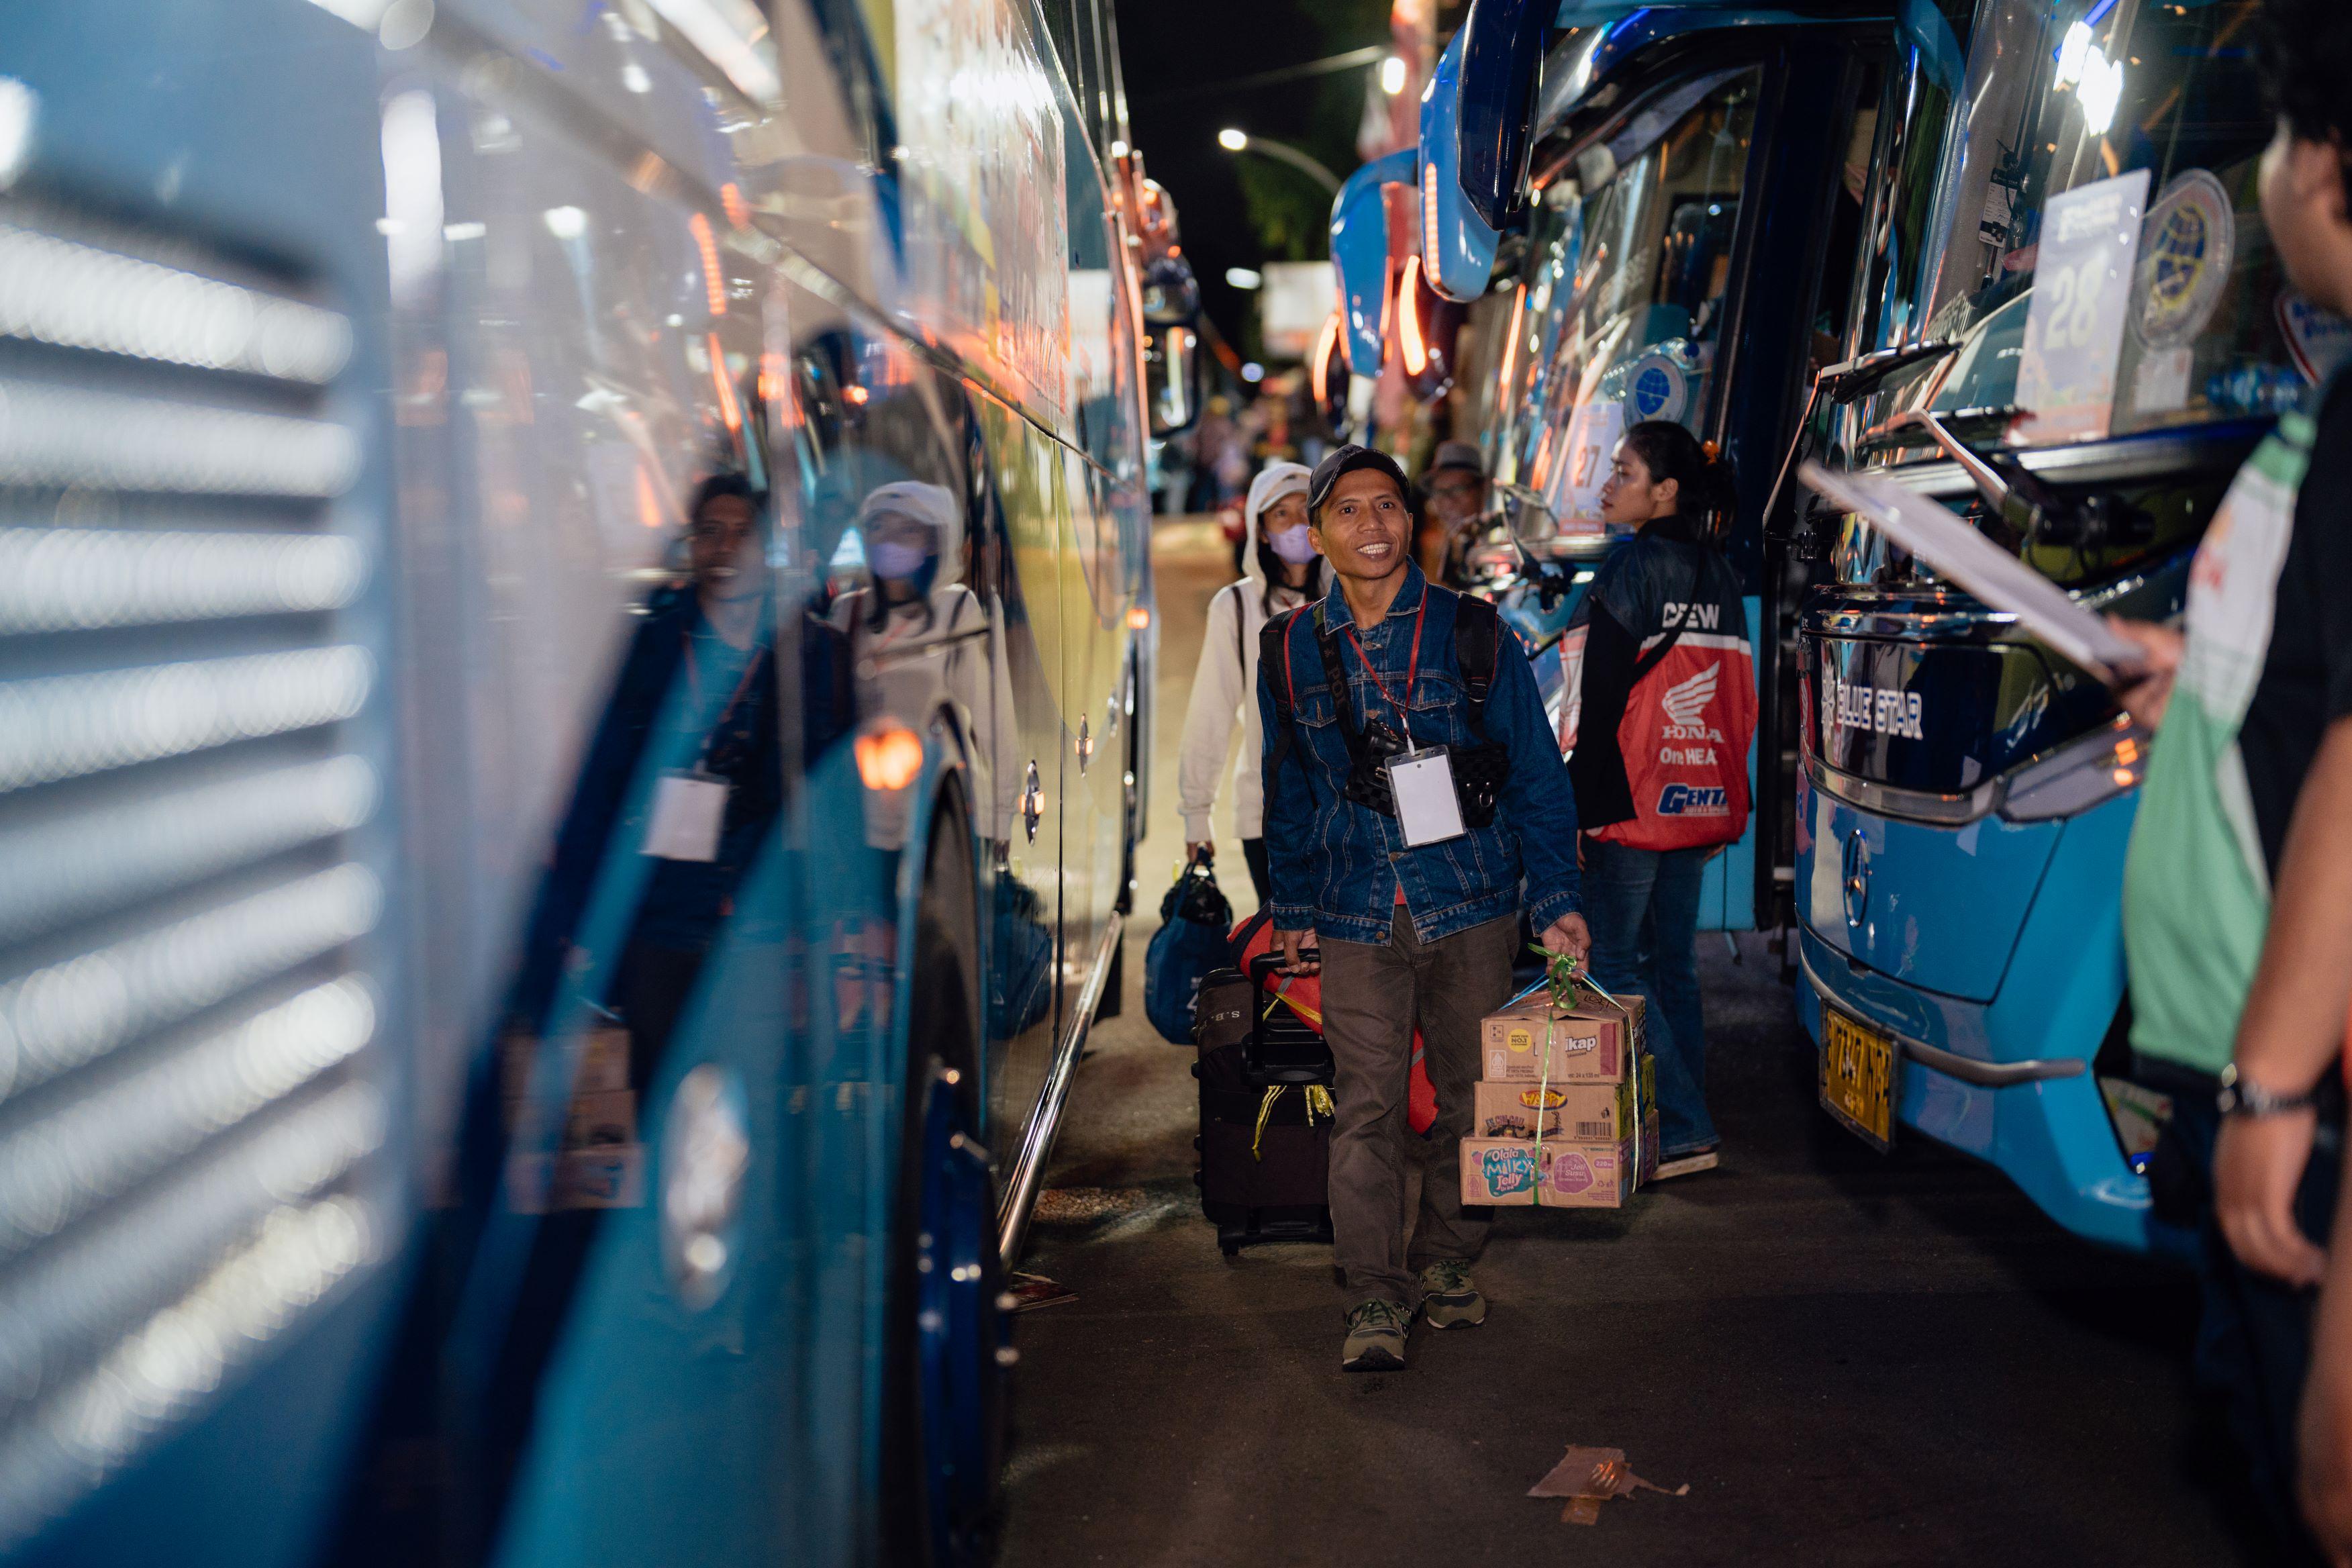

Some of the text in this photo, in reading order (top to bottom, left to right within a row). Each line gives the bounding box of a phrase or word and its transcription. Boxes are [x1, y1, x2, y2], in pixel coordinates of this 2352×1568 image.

[2044, 252, 2109, 350] 28
[1575, 444, 1601, 489] 27
[1836, 683, 1924, 740] BLUE STAR
[1522, 1091, 1567, 1107] HAPPY
[1491, 1148, 1519, 1162] Olala
[1496, 1173, 1523, 1191] Jelly
